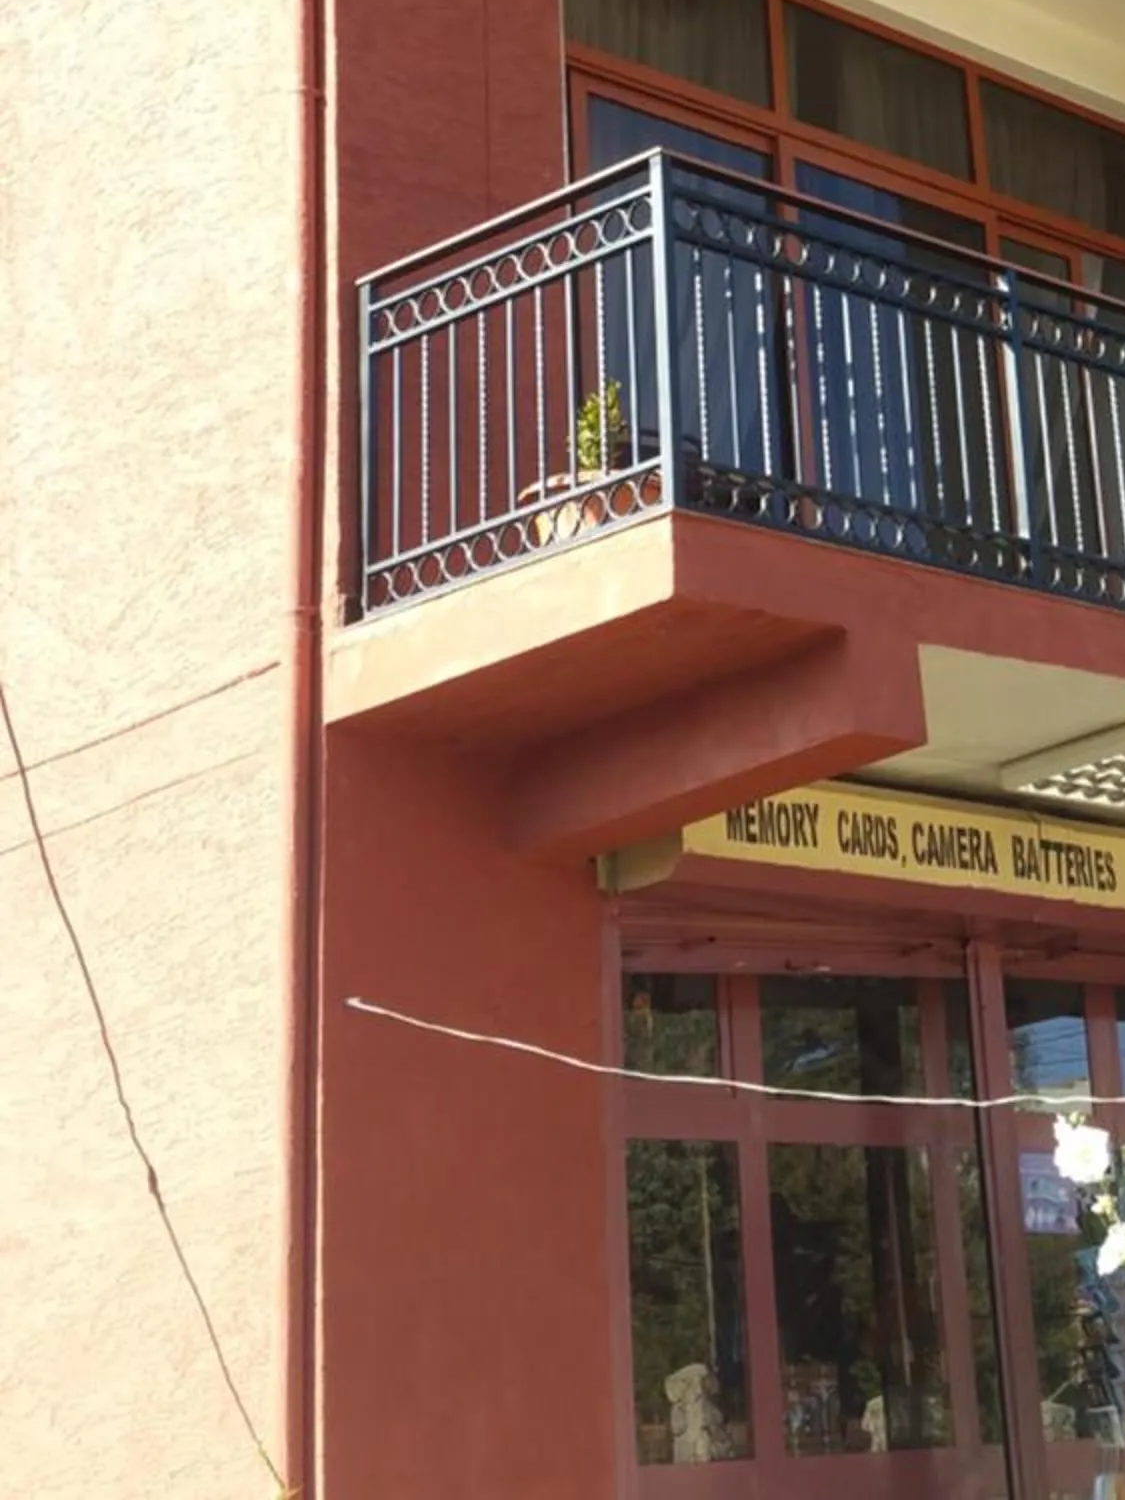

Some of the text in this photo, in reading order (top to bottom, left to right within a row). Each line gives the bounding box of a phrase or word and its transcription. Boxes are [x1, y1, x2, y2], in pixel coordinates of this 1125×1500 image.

[725, 801, 819, 849] MEMORY
[836, 809, 908, 869] CARDS,
[911, 821, 999, 875] CAMERA
[1011, 835, 1117, 893] BATTERIES
